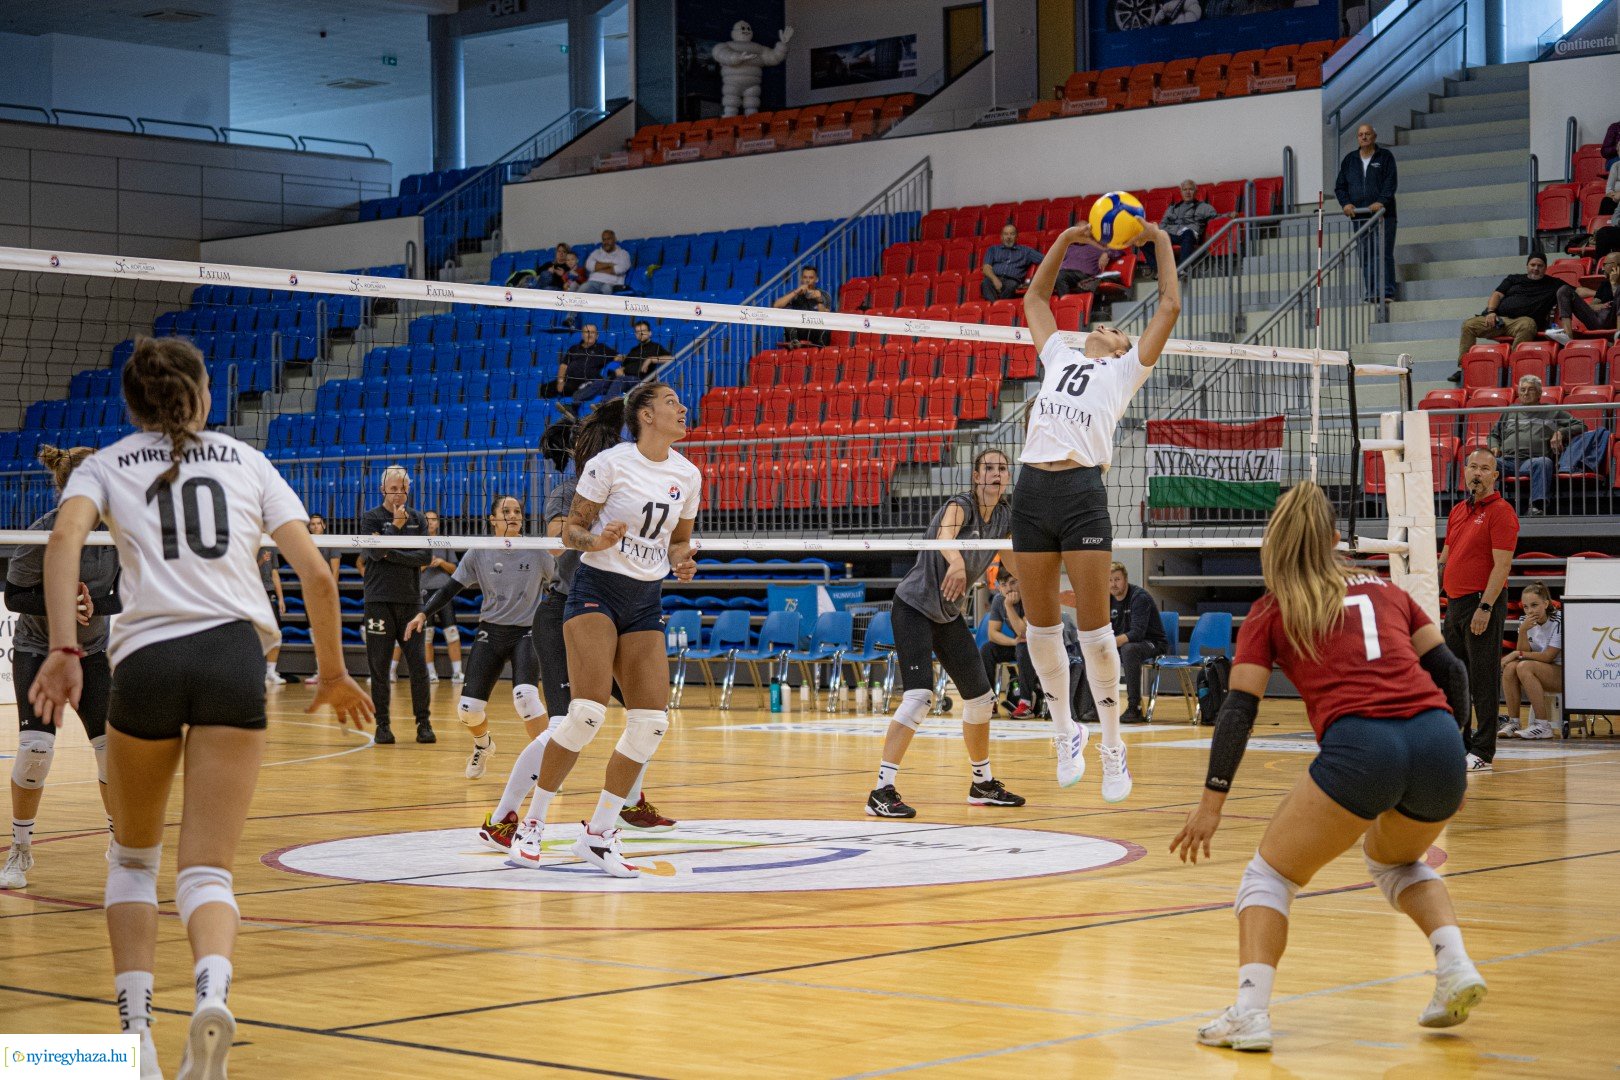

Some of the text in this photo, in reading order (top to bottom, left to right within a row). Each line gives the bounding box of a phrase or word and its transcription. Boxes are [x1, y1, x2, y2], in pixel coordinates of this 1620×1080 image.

[1554, 34, 1619, 55] Continental
[1258, 79, 1295, 88] MICHELIN
[1070, 100, 1106, 110] MICHELIN
[985, 109, 1017, 120] MICHELIN
[669, 147, 699, 157] MICHELIN
[199, 266, 231, 281] FATUM
[426, 284, 455, 299] FATUM
[624, 300, 650, 312] FATUM
[801, 313, 825, 325] FATUM
[959, 325, 981, 337] FATUM
[1055, 363, 1094, 397] 15
[1039, 397, 1092, 427] FATUM
[117, 443, 242, 468] NYÍREYHÁZA
[145, 476, 230, 561] 10
[640, 501, 670, 540] 17
[427, 538, 452, 548] FATUM
[1343, 594, 1382, 661] 7
[477, 630, 489, 643] 2
